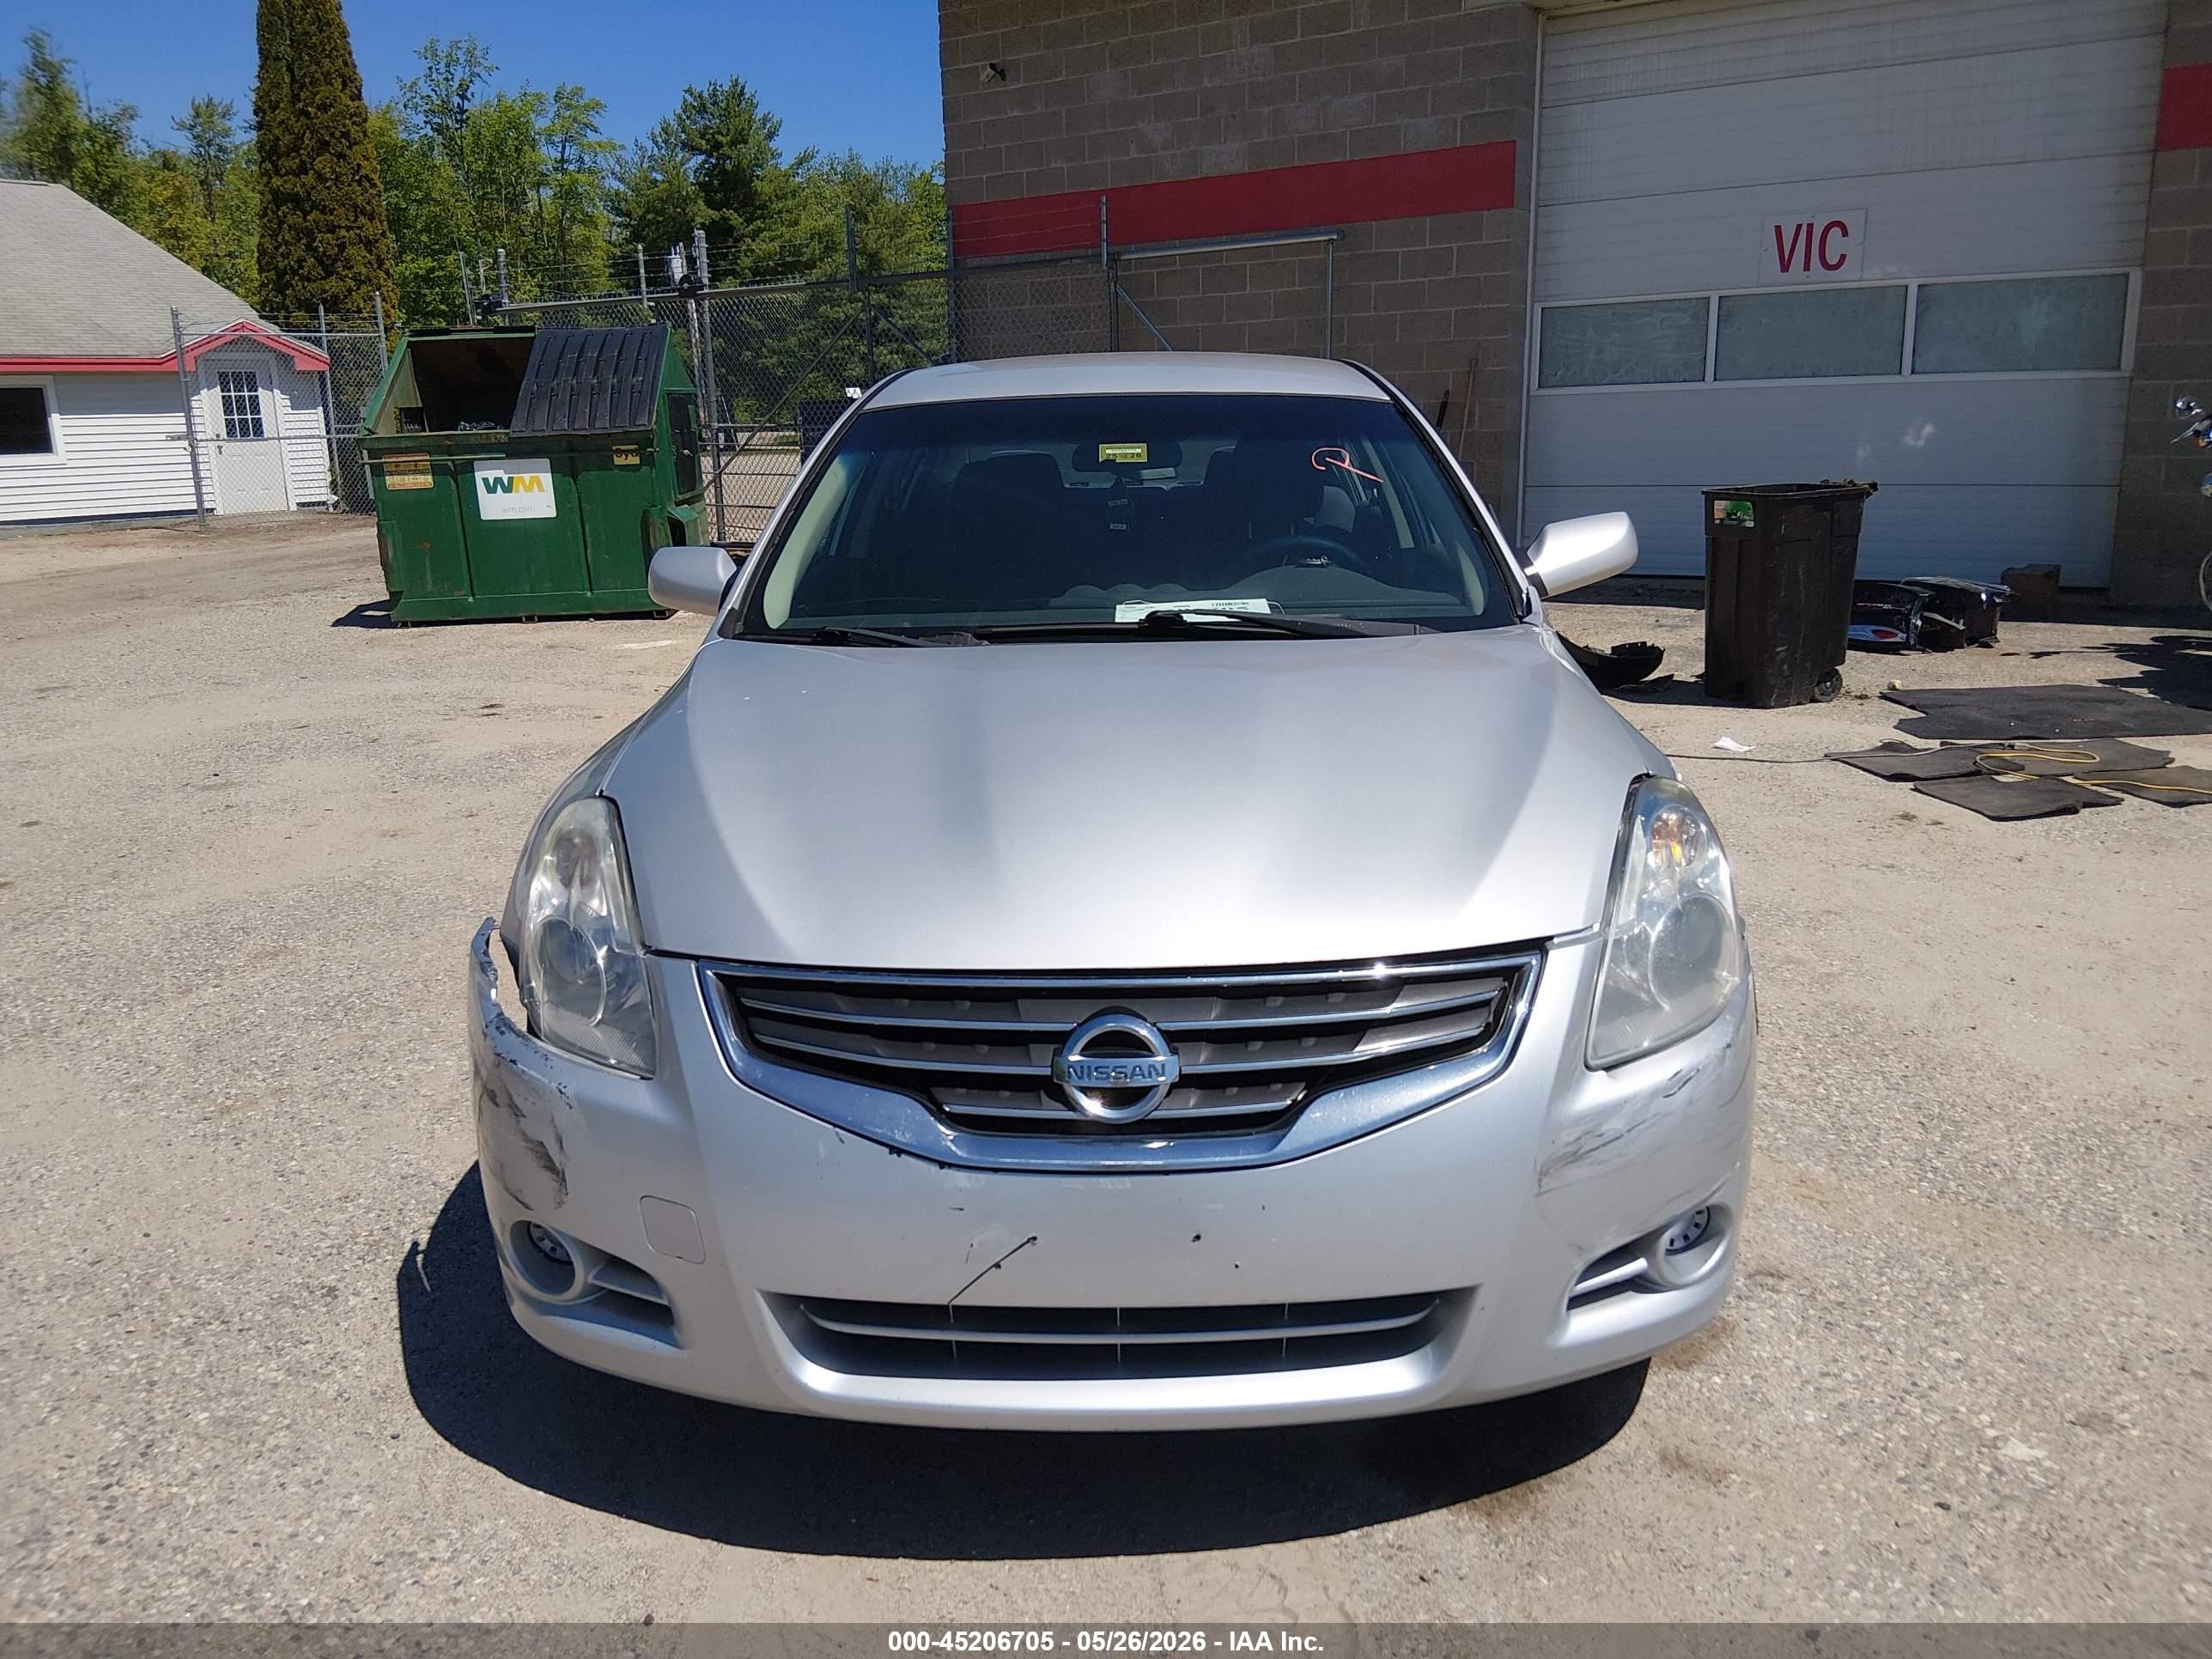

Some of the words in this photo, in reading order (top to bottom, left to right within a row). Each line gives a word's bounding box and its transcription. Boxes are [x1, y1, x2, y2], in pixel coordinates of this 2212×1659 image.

[1774, 220, 1848, 273] VIC
[482, 475, 545, 494] WM
[1067, 1064, 1166, 1081] NISSAN
